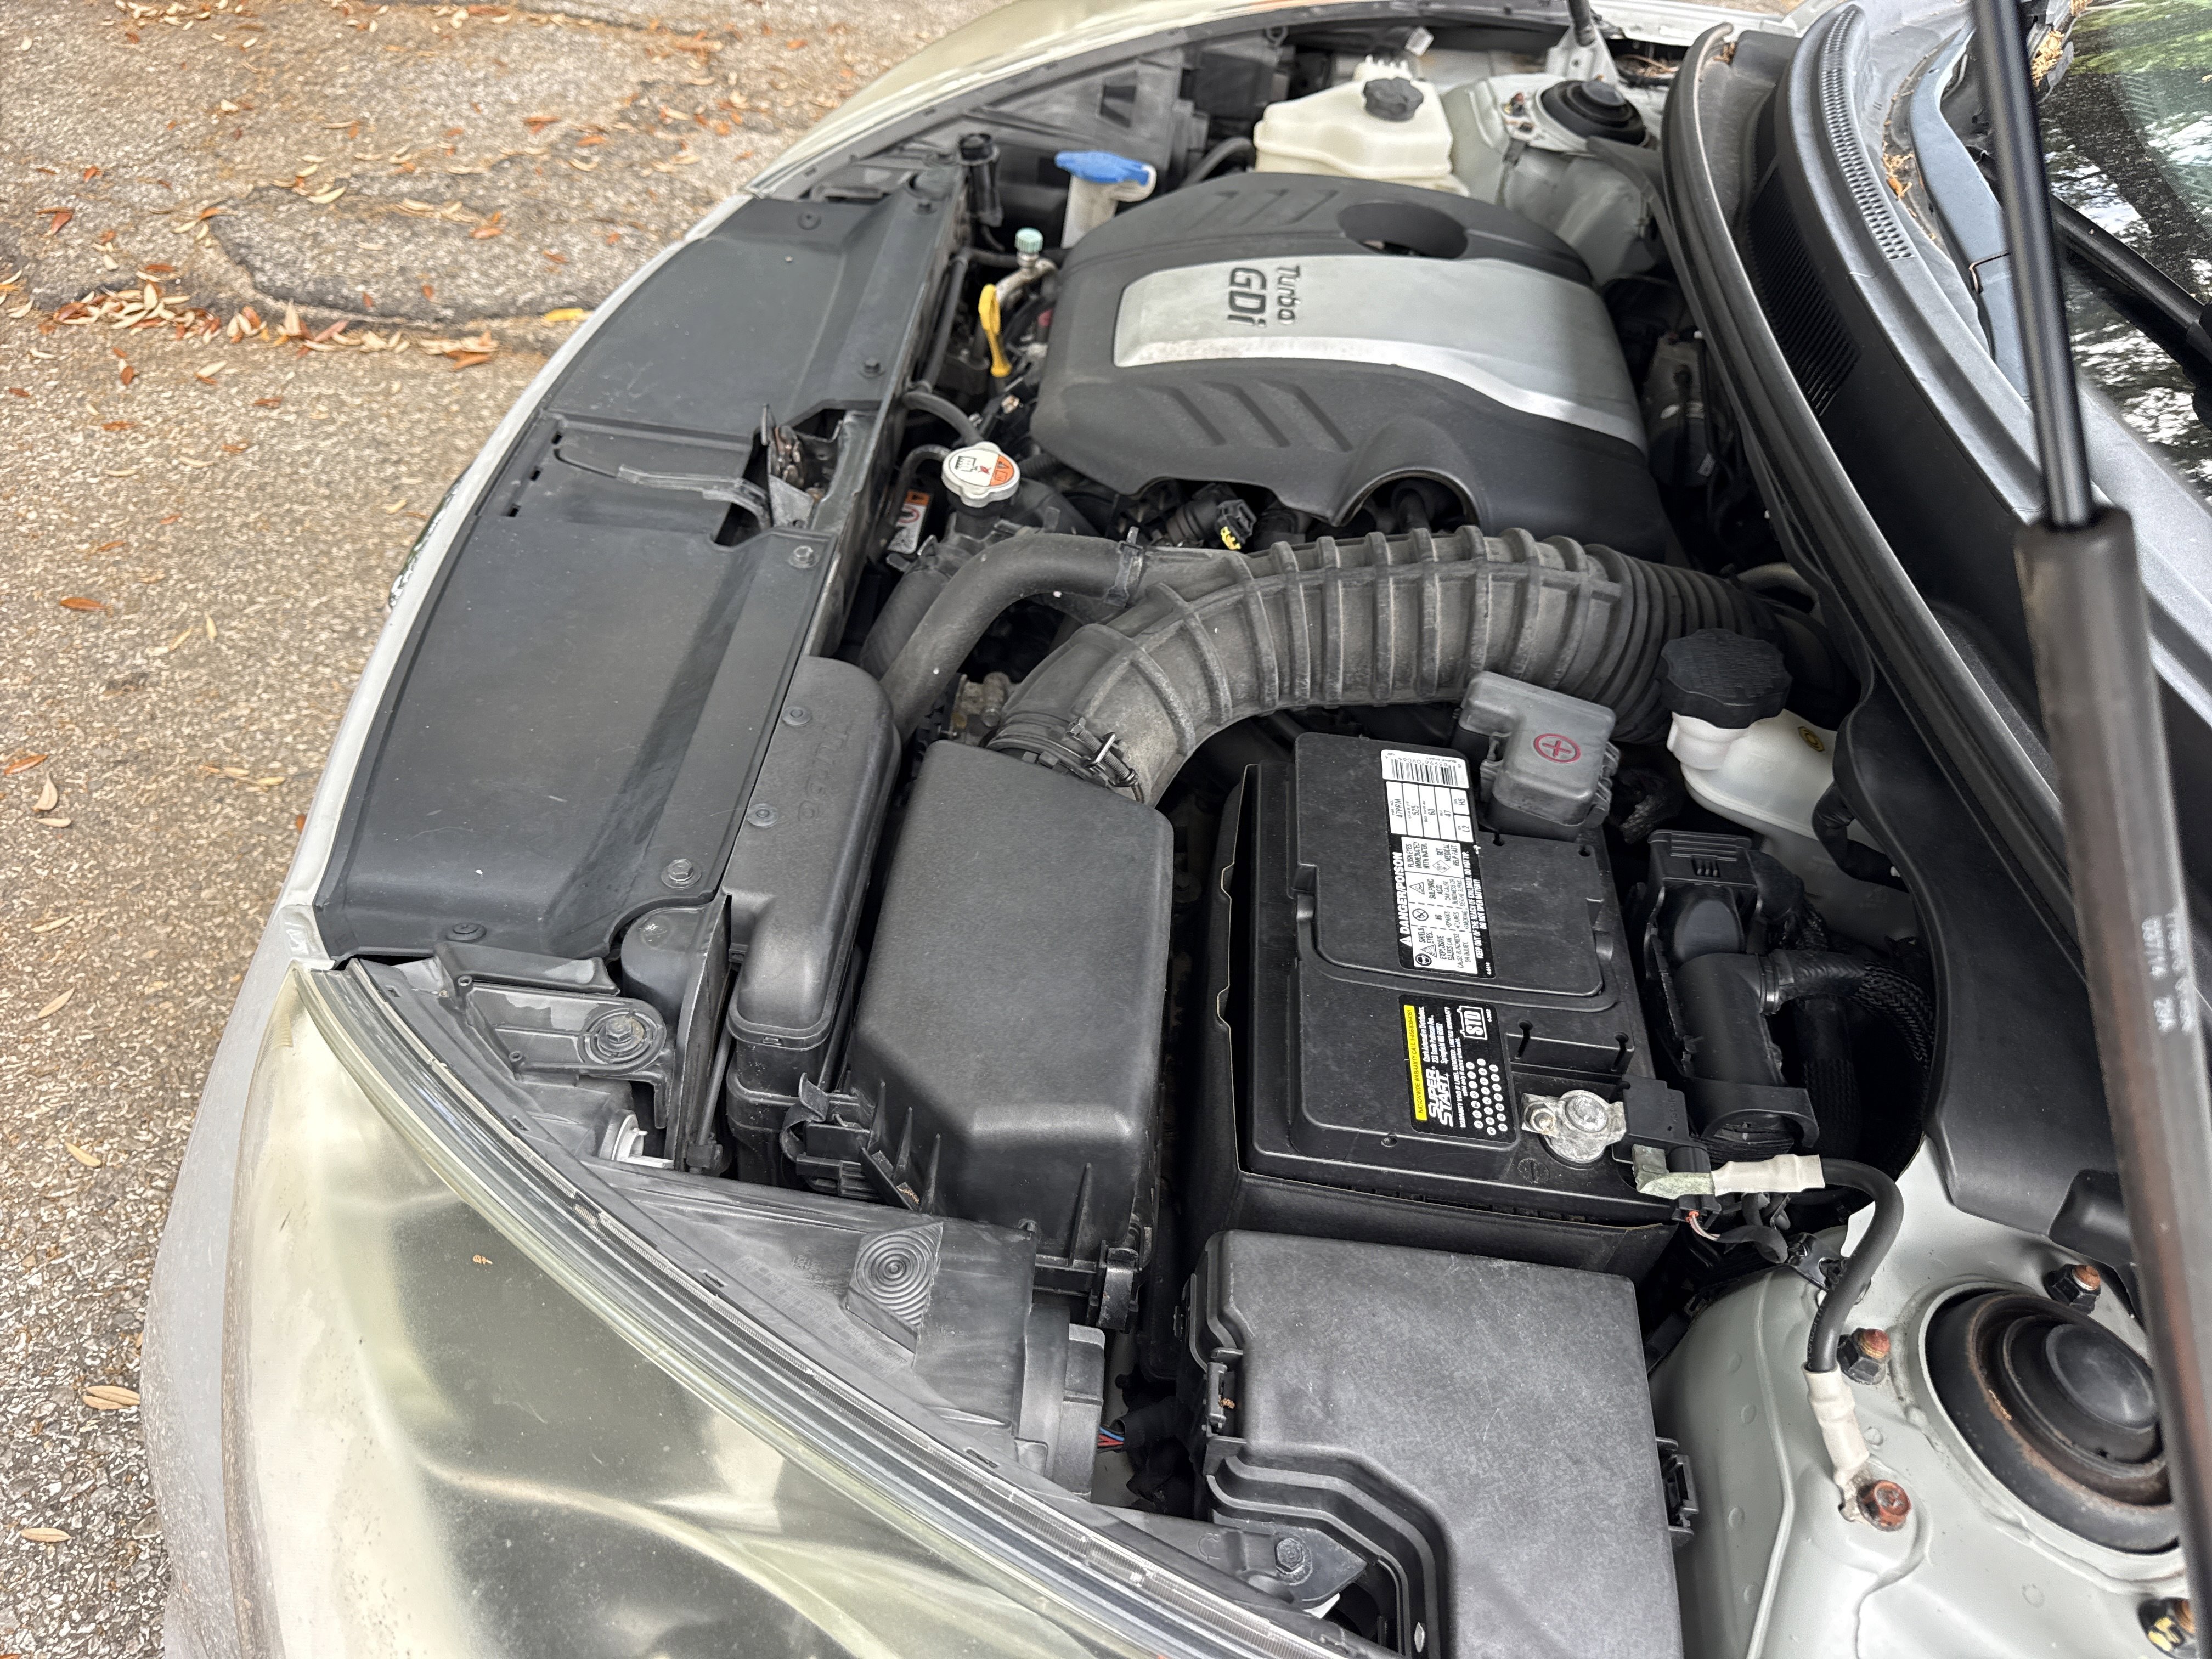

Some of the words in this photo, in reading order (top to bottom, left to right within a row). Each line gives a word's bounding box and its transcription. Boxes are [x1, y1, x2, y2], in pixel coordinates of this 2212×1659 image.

[1226, 267, 1266, 327] GDi
[1277, 265, 1301, 325] Turbo
[1394, 798, 1403, 817] 47PRM
[1410, 805, 1419, 815] 525
[1412, 841, 1421, 868] IMMEDIATELY
[1443, 843, 1451, 861] MEDICAL
[1392, 851, 1410, 934] DANGER/POISON
[1426, 878, 1436, 899] SULFURIC
[1469, 905, 1477, 920] REACH
[1475, 899, 1485, 912] OPEN
[1471, 920, 1479, 929] THE
[1477, 912, 1486, 922] NOT
[1417, 927, 1425, 942] SHIELD
[1473, 936, 1481, 946] OUT
[1437, 935, 1446, 959] EXPLOSIVE
[1446, 946, 1454, 960] GASES
[1475, 946, 1483, 958] KEEP
[1444, 1006, 1453, 1030] WARRANTY
[1463, 1010, 1483, 1035] STD
[1412, 1055, 1420, 1082] WARRANTY
[1415, 1082, 1423, 1113] NATIONWIDE
[1424, 1068, 1441, 1118] SUPER
[1434, 1069, 1453, 1127] START
[1457, 1102, 1466, 1128] WARRANTY
